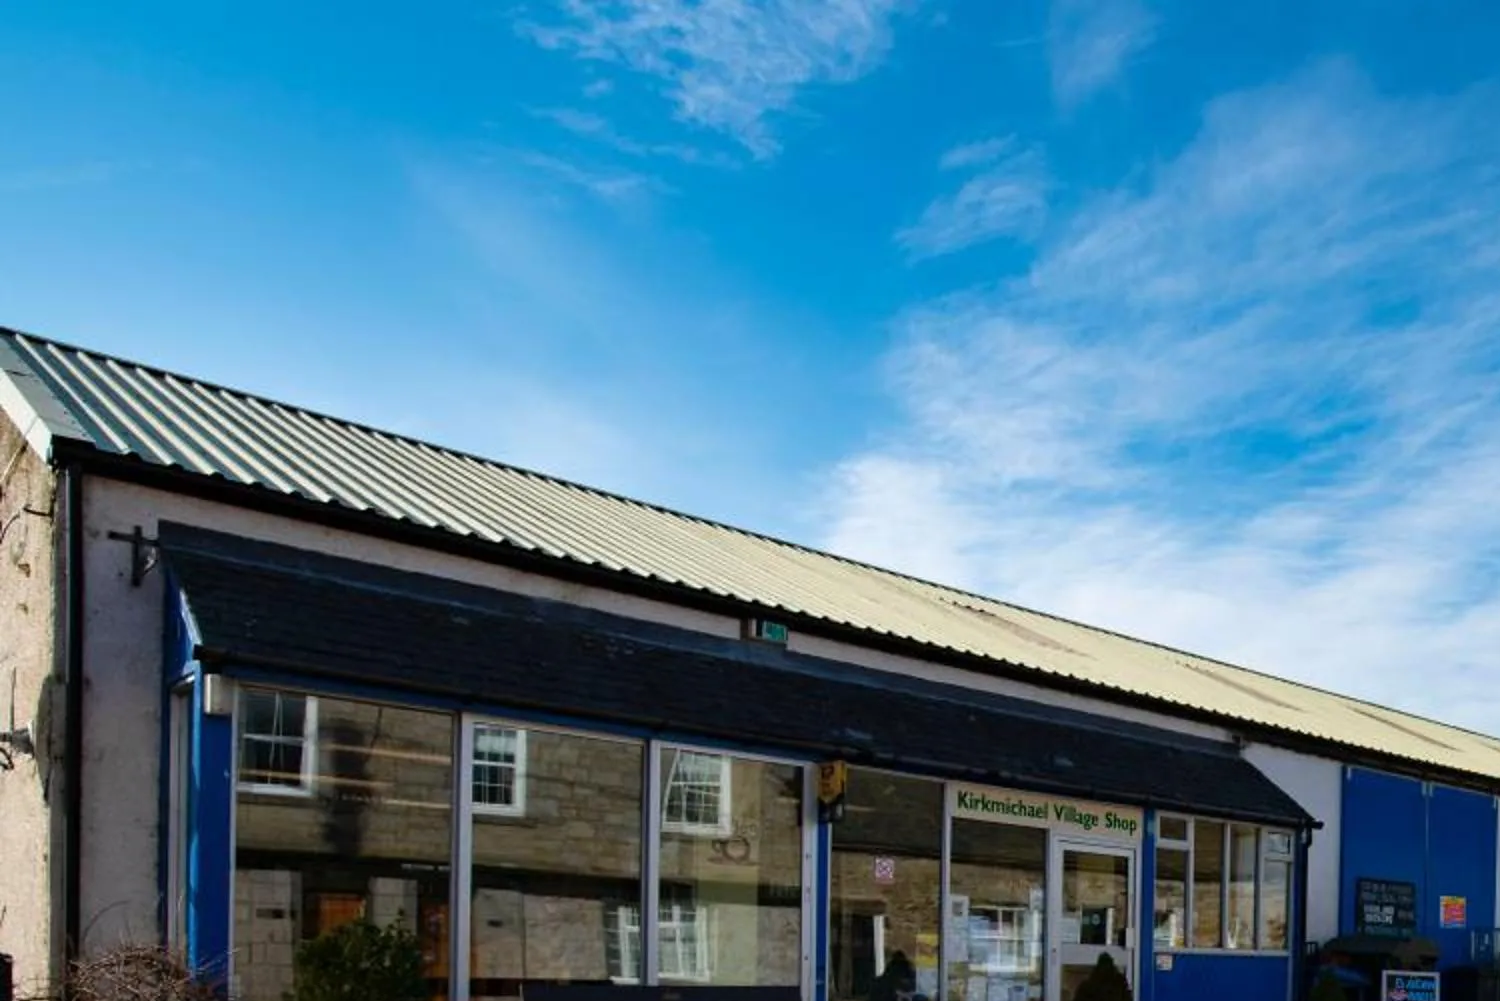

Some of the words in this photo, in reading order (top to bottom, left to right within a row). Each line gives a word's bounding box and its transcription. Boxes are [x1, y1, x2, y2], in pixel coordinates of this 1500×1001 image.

[957, 791, 1049, 819] Kirkmichael
[1053, 804, 1099, 831] Village
[1105, 812, 1137, 836] Shop
